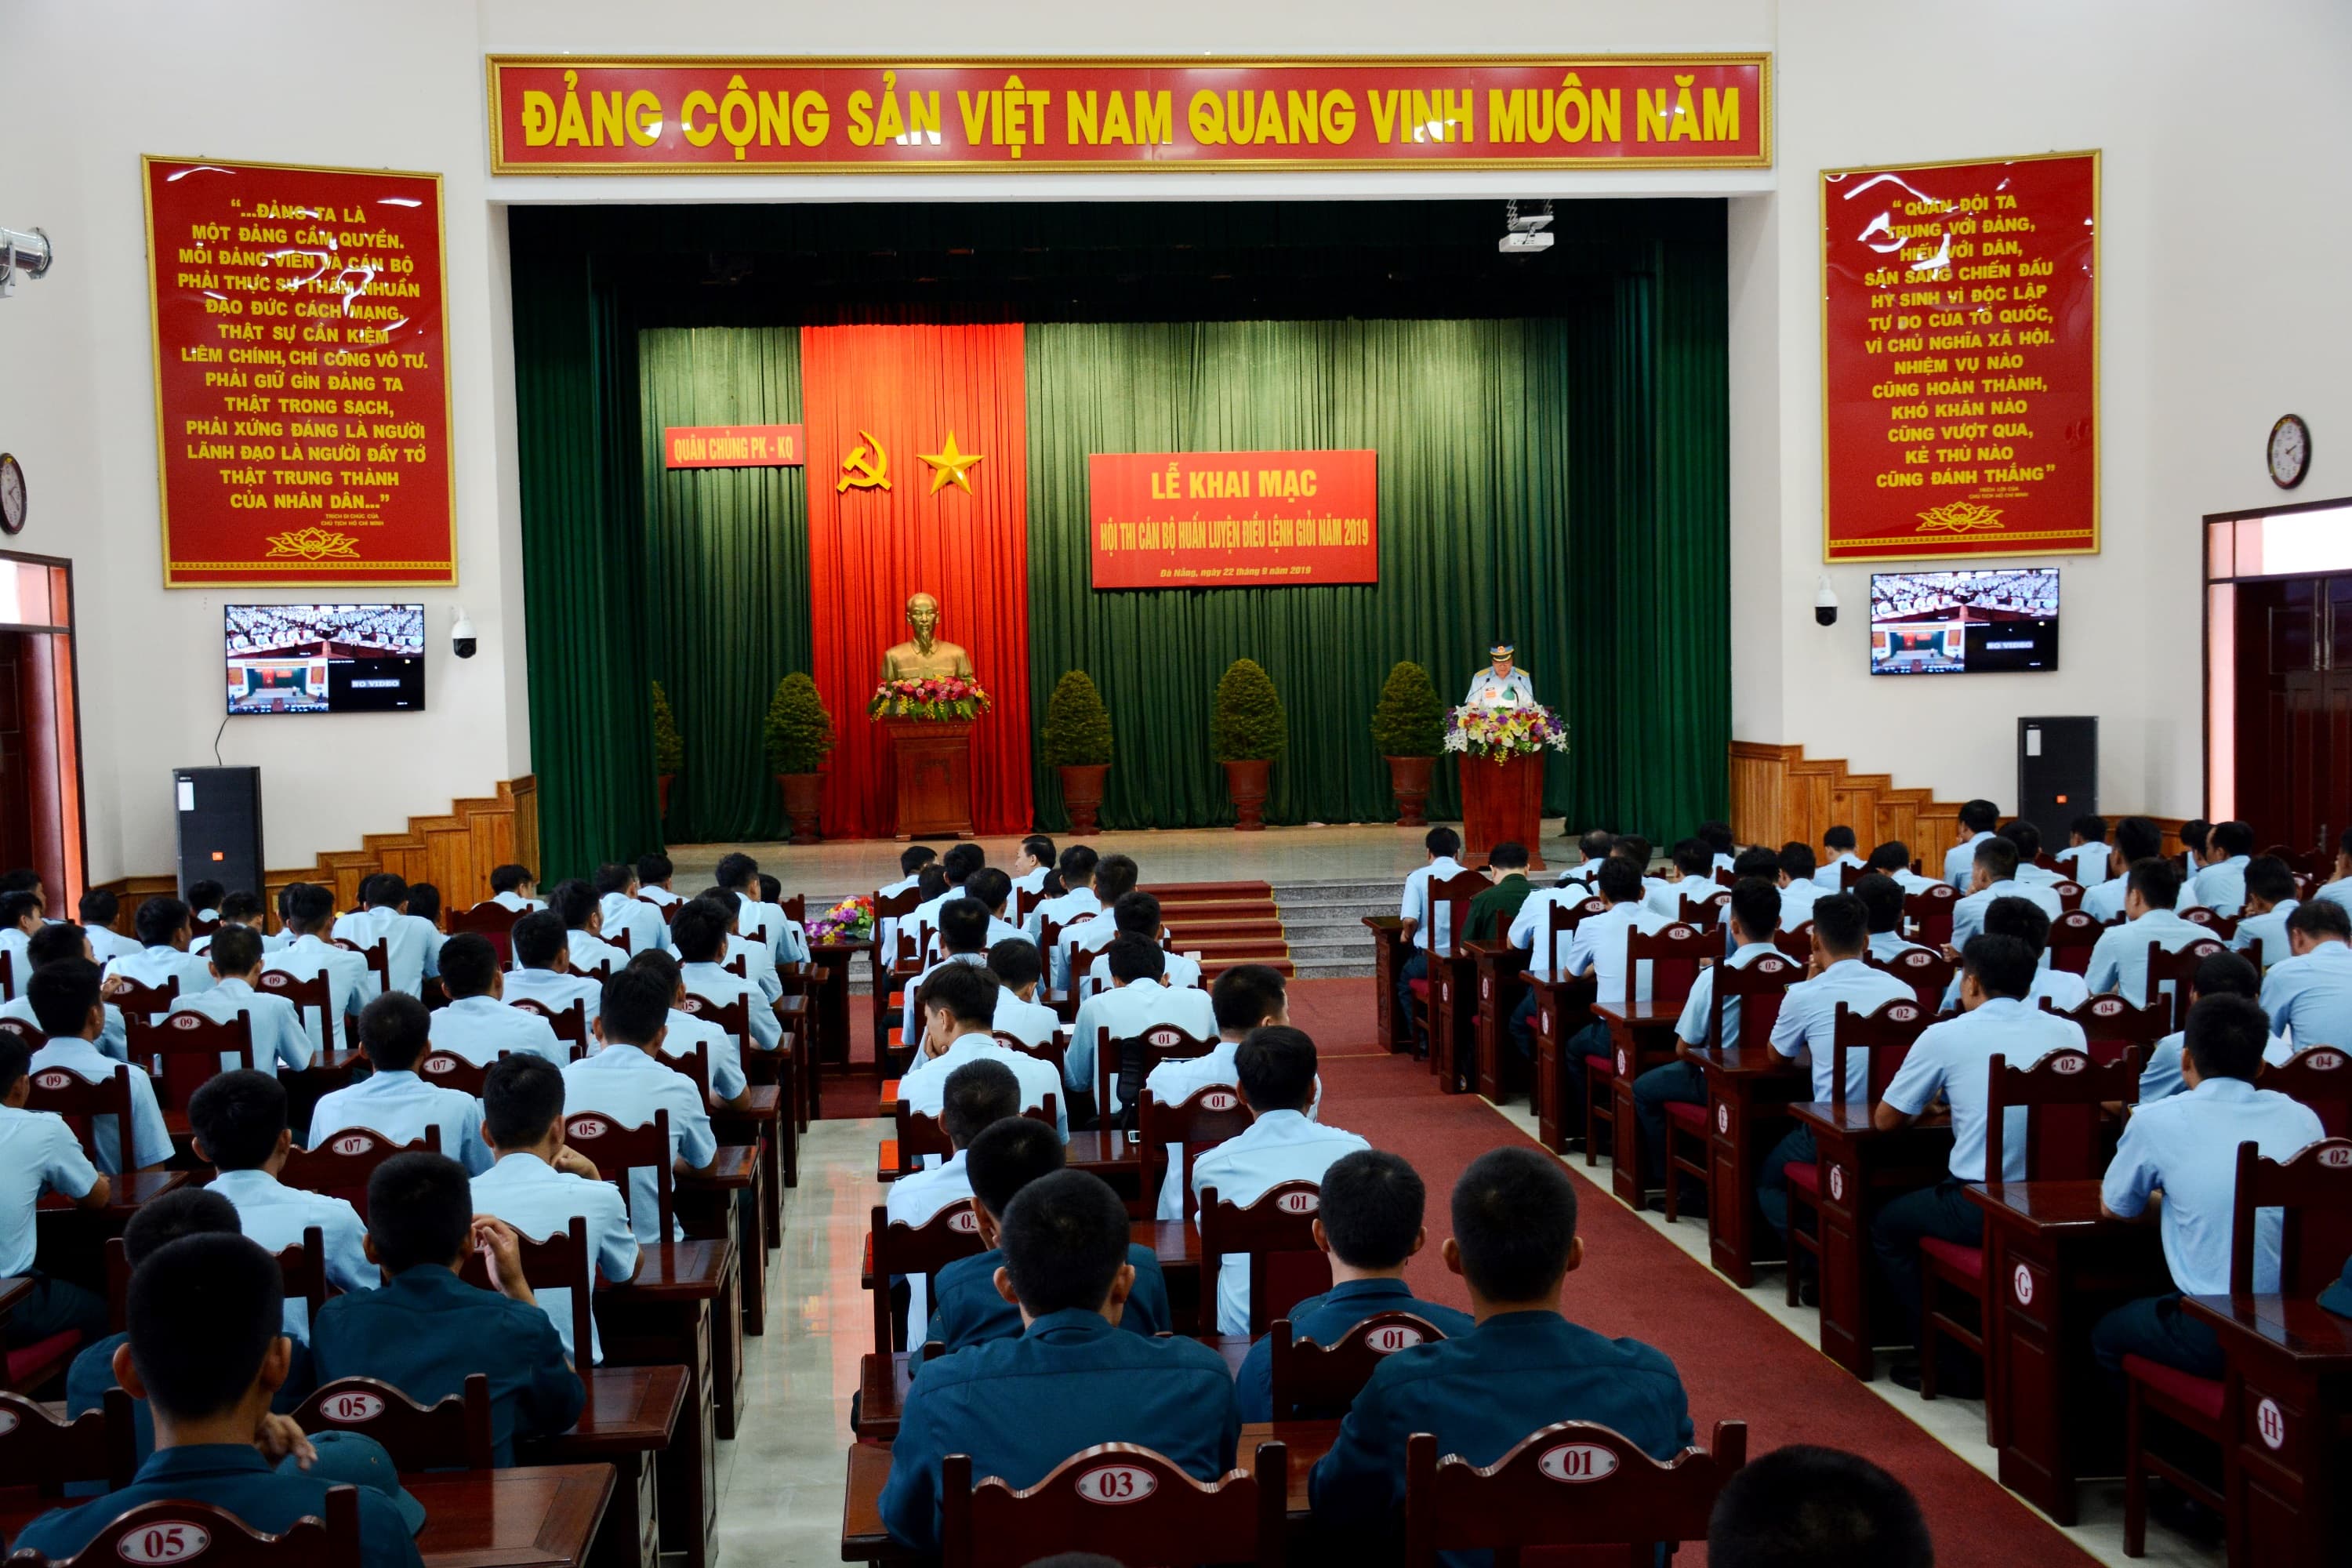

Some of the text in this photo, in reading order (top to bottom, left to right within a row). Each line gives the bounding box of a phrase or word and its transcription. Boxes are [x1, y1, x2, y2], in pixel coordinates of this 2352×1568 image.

[522, 70, 1740, 160] ĐẢNG CỘNG SẢN VIỆT NAM QUANG VINH MUÔN NĂM
[1960, 194, 2016, 212] ĐỘI TA
[314, 207, 365, 223] TA LÀ
[192, 223, 230, 240] MỘT
[238, 223, 287, 243] ĐẢNG
[1888, 215, 2034, 238] TRUNG VỚI ĐẢNG,
[1983, 239, 2022, 256] DÂN,
[219, 247, 413, 274] ĐẢNG CÁN BỘ
[1959, 259, 2053, 280] CHIẾN ĐẤU
[179, 270, 270, 291] PHẢI THỰC
[1872, 282, 2047, 308] HY SINH VÌ ĐỘC LẬP
[205, 299, 341, 318] ĐẠO ĐỨC CÁCH
[1869, 304, 2053, 332] TỰ DO CỦA QUỐC,
[218, 322, 389, 344] THẬT SỰ CẦN KIỆM
[1865, 338, 1882, 354] VÌ
[1888, 332, 1923, 352] CHỦ
[1929, 331, 1982, 350] NGHĨA
[1989, 329, 2013, 347] XÃ
[182, 345, 222, 362] LIÊM
[229, 347, 285, 367] CHÍNH,
[289, 349, 318, 365] CHÍ
[325, 352, 370, 367] CÔNG
[375, 351, 398, 368] VÔ
[1895, 354, 2023, 376] NHIỆM VỤ NÀO
[206, 368, 403, 391] PHẢI GIỮ GÌN ĐẢNG TA
[1872, 377, 2047, 398] CŨNG HOÀN THÀNH,
[225, 394, 394, 417] THẬT TRONG SẠCH,
[1892, 399, 2027, 419] KHÓ KHĂN NÀO
[187, 418, 425, 439] PHẢI XỨNG ĐÁNG LÀ NGƯỜI
[1888, 423, 2033, 442] CŨNG VƯỢT QUA,
[188, 441, 426, 463] LÃNH ĐẠO LÀ NGƯỜI ĐẦY TỚ
[674, 434, 706, 463] QUÂN
[751, 437, 767, 459] PK
[778, 436, 793, 460] KQ
[1906, 444, 2013, 463] KẺ THÙ NÀO
[220, 466, 399, 486] THẬT TRUNG THÀNH
[1152, 462, 1316, 503] LỄ KHAI MẠC
[1877, 470, 1977, 488] CŨNG ĐÁNH
[230, 489, 322, 508] CỦA NHÂN
[1100, 517, 1117, 557] HỘI
[1120, 523, 1135, 550] THI
[1138, 516, 1160, 550] CÁN
[1162, 515, 1176, 556] BỘ
[1178, 511, 1206, 549] HUẤN
[1209, 514, 1240, 554] LUYỆN
[1268, 514, 1293, 553] LỆNH
[1296, 510, 1316, 546] GIỎI
[1319, 513, 1341, 546] NĂM
[1345, 518, 1368, 546] 2019
[1674, 929, 1685, 938] 02
[1765, 962, 1776, 971] 02
[1913, 956, 1924, 964] 04
[269, 977, 280, 985] 09
[1896, 1008, 1909, 1018] 02
[2100, 1003, 2114, 1013] 04
[180, 1018, 193, 1027] 09
[1158, 1033, 1171, 1044] 01
[433, 1060, 447, 1070] 07
[2060, 1057, 2077, 1070] 02
[2316, 1056, 2332, 1068] 04
[46, 1076, 61, 1087] 09
[1212, 1096, 1225, 1108] 01
[579, 1121, 596, 1135] 05
[1720, 1109, 1725, 1129] E
[344, 1139, 361, 1152] 07
[2330, 1149, 2348, 1164] 02
[1833, 1173, 1839, 1193] F
[1290, 1195, 1308, 1210] 01
[2017, 1272, 2027, 1297] G
[1382, 1330, 1403, 1349] 01
[339, 1396, 367, 1417] 05
[2263, 1406, 2278, 1440] H
[1563, 1450, 1594, 1475] 01
[1099, 1472, 1134, 1497] 03
[144, 1528, 184, 1559] 05
